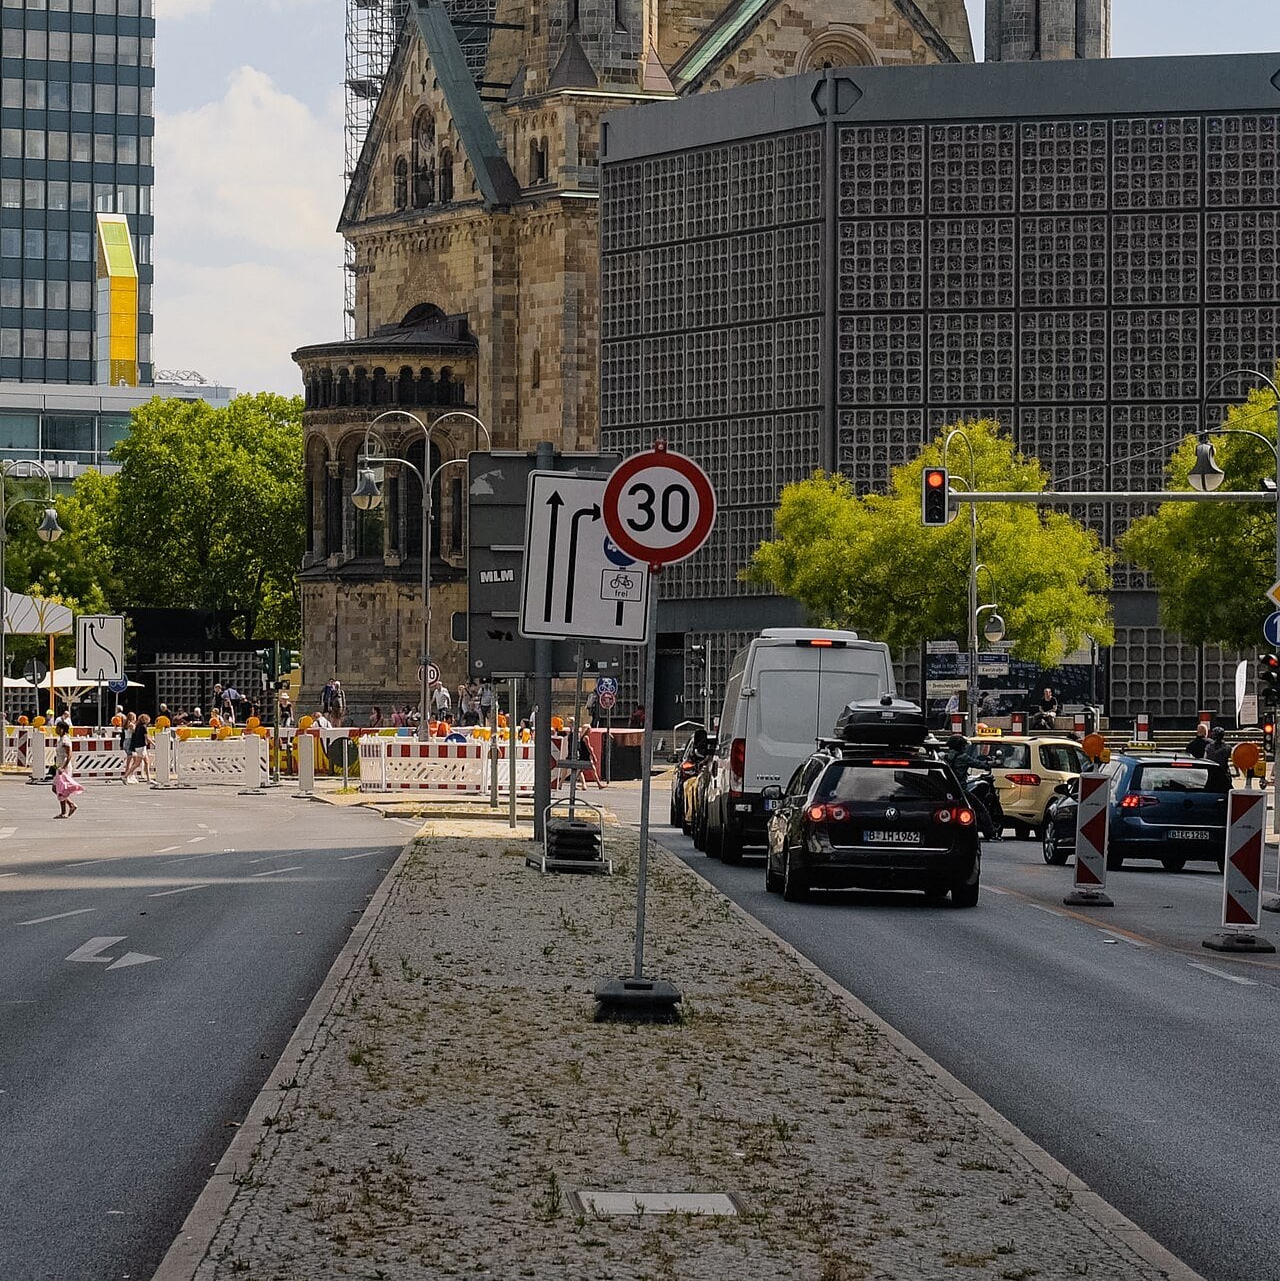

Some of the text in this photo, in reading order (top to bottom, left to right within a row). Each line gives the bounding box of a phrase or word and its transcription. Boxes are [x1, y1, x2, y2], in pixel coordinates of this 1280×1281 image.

[627, 482, 690, 533] 30
[479, 569, 515, 584] MLM
[614, 589, 629, 598] frei
[896, 831, 920, 842] 1962
